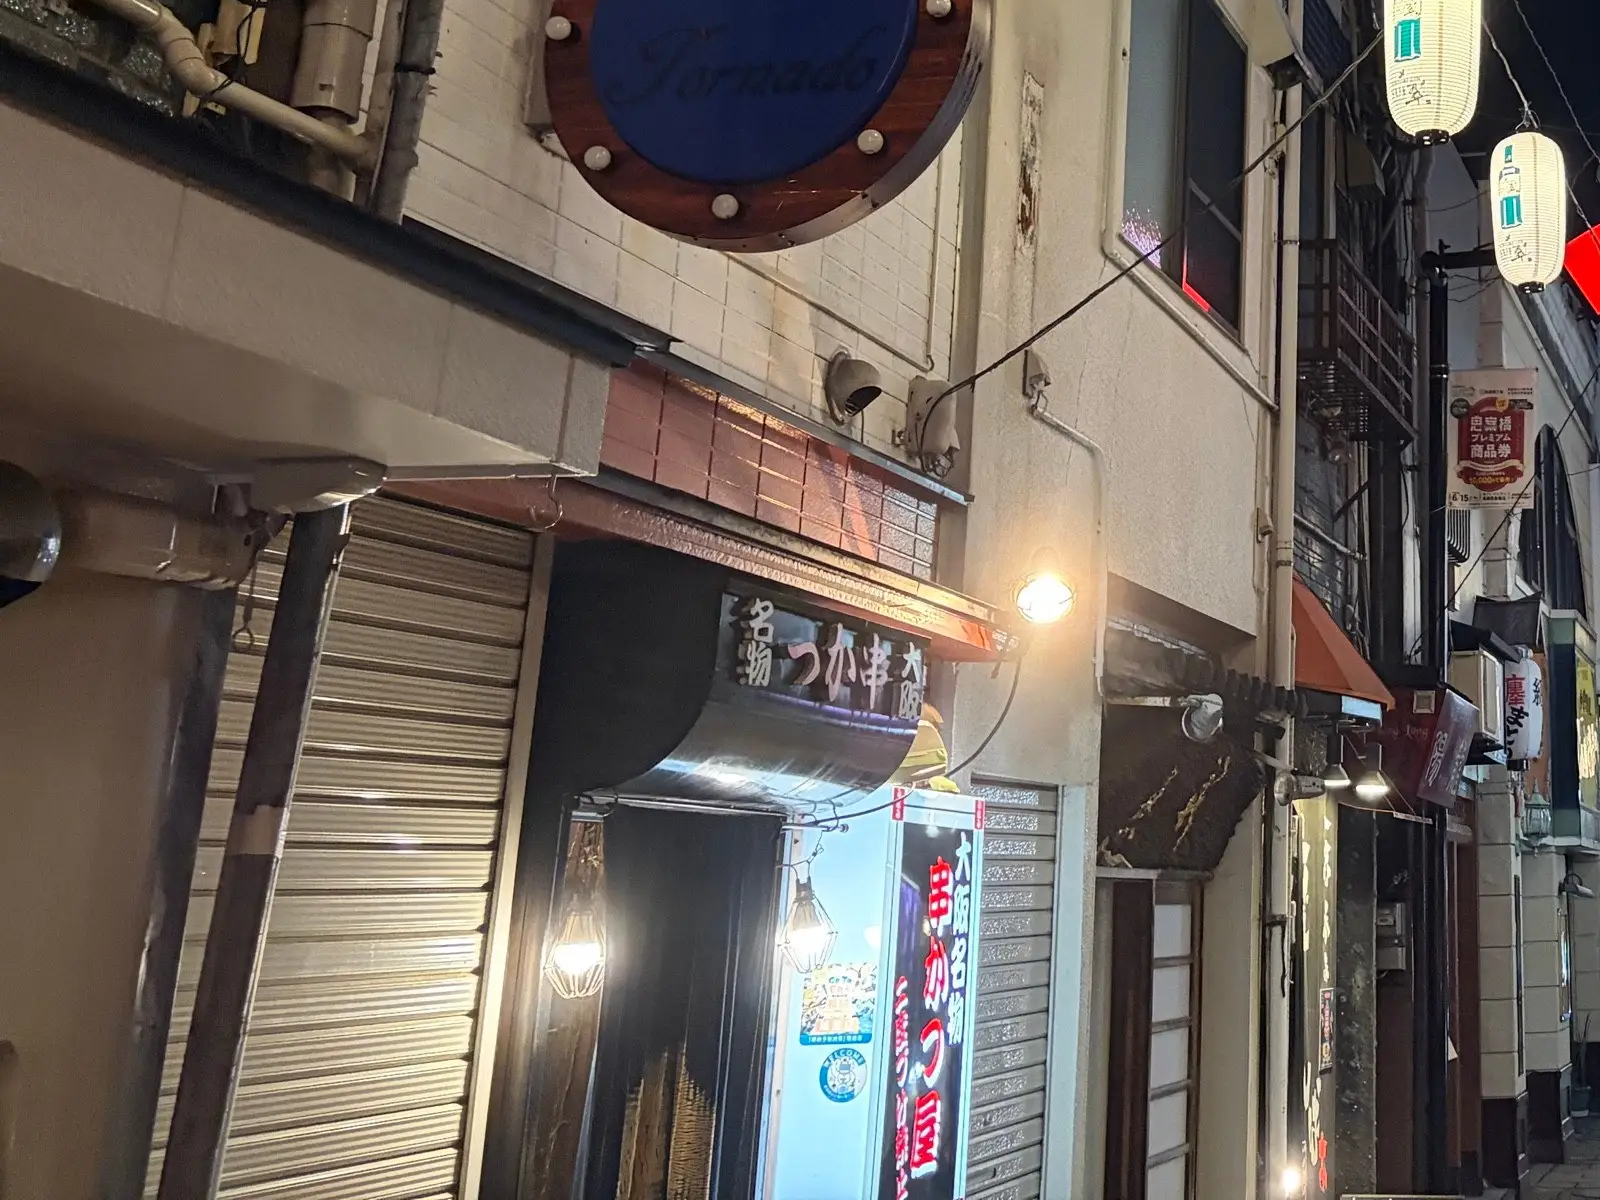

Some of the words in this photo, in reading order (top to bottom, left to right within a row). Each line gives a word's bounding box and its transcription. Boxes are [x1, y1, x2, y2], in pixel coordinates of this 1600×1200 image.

[1470, 416, 1511, 432] 思案橋
[1470, 444, 1511, 458] 商品券
[1471, 434, 1511, 442] プレミアム
[745, 598, 774, 687] 名物
[899, 642, 922, 720] 大阪
[948, 831, 971, 1045] 大阪名物
[910, 855, 953, 1179] 串かつ屋
